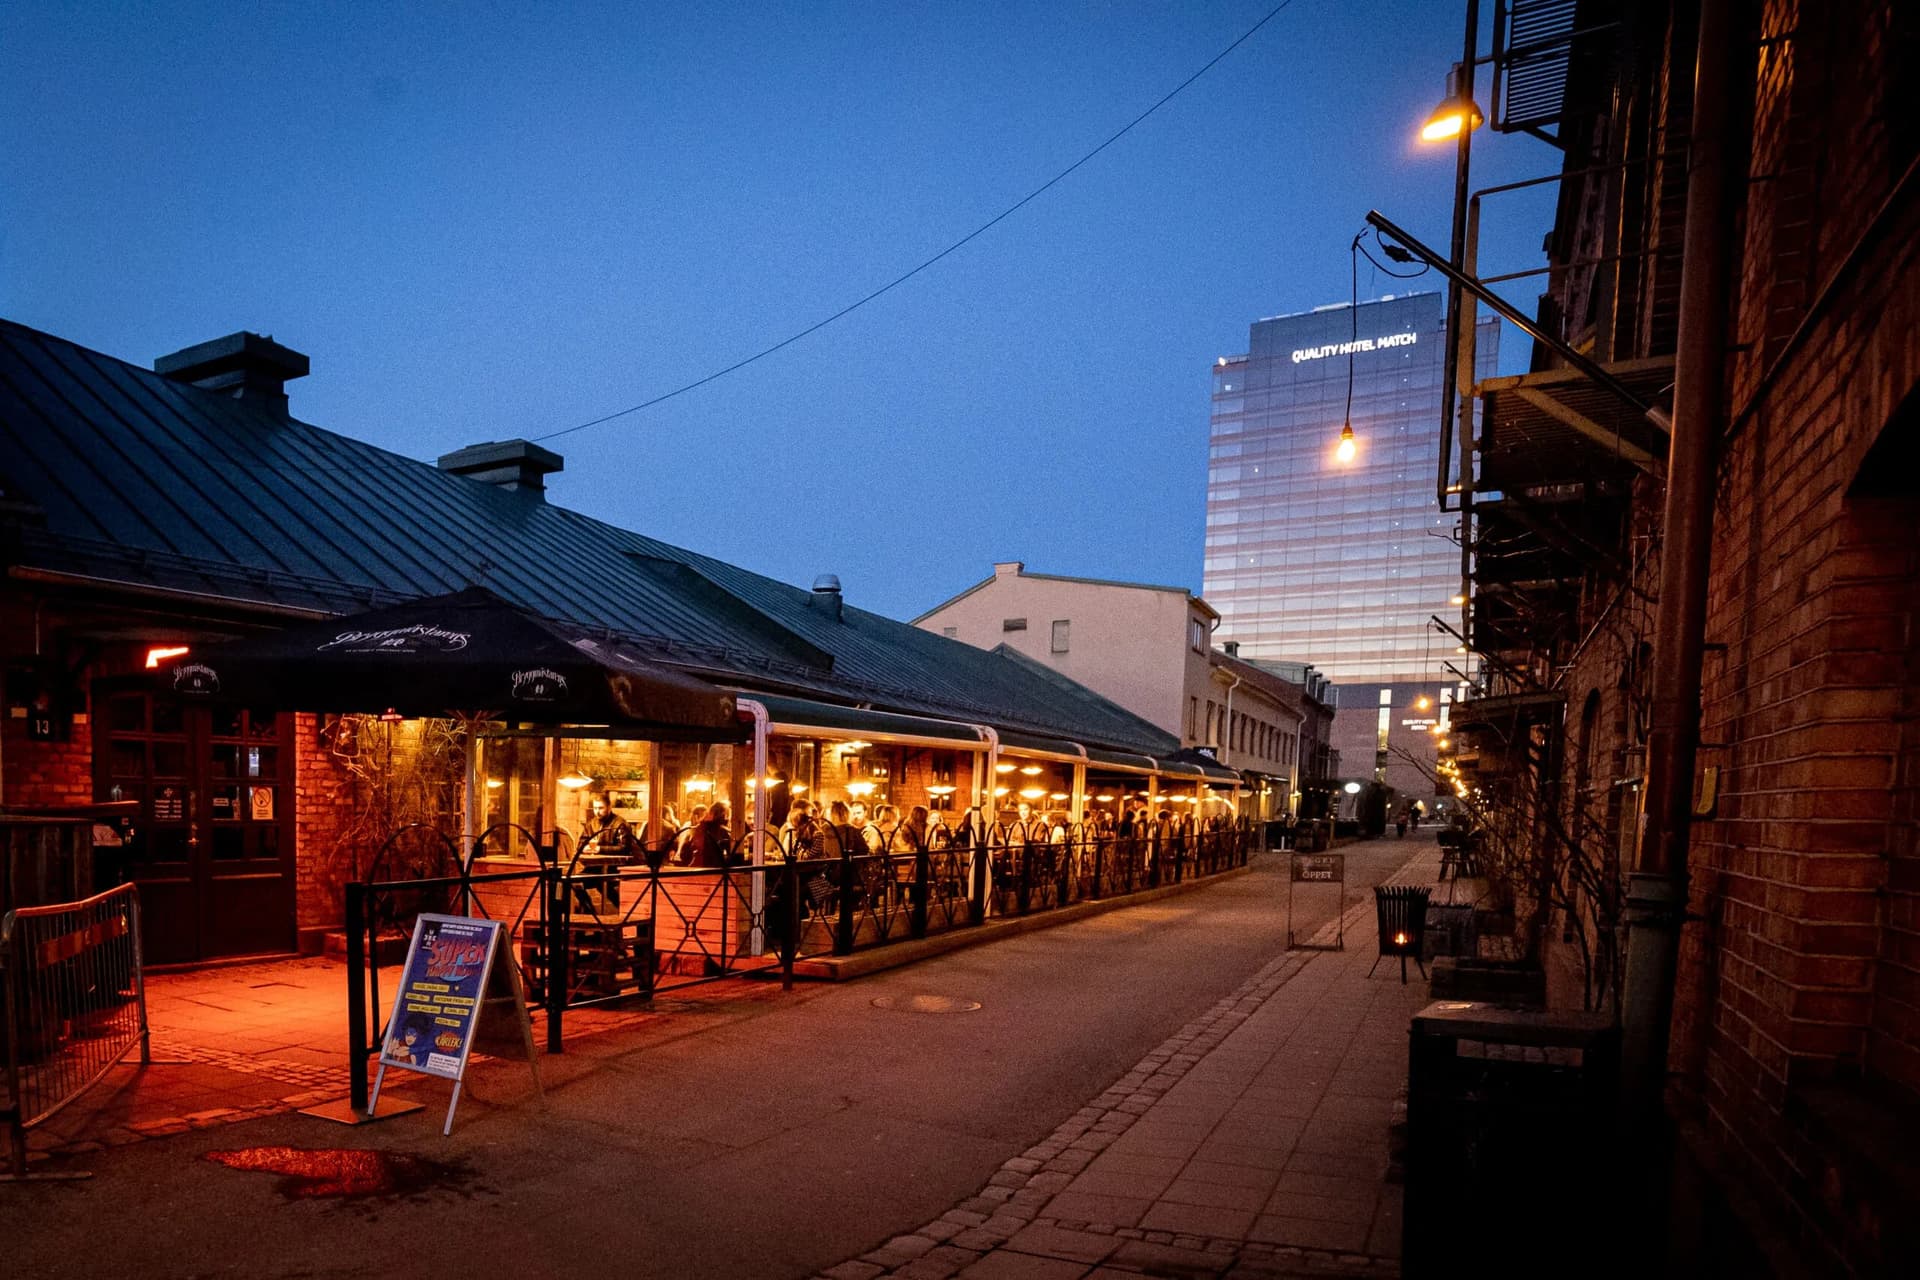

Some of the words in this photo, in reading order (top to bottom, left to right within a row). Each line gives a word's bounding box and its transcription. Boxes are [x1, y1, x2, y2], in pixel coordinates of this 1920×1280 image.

[1292, 344, 1339, 363] QUALITY
[1339, 339, 1376, 354] HOTEL
[1377, 332, 1417, 349] MATCH
[35, 719, 50, 736] 13
[427, 940, 486, 965] SUPER
